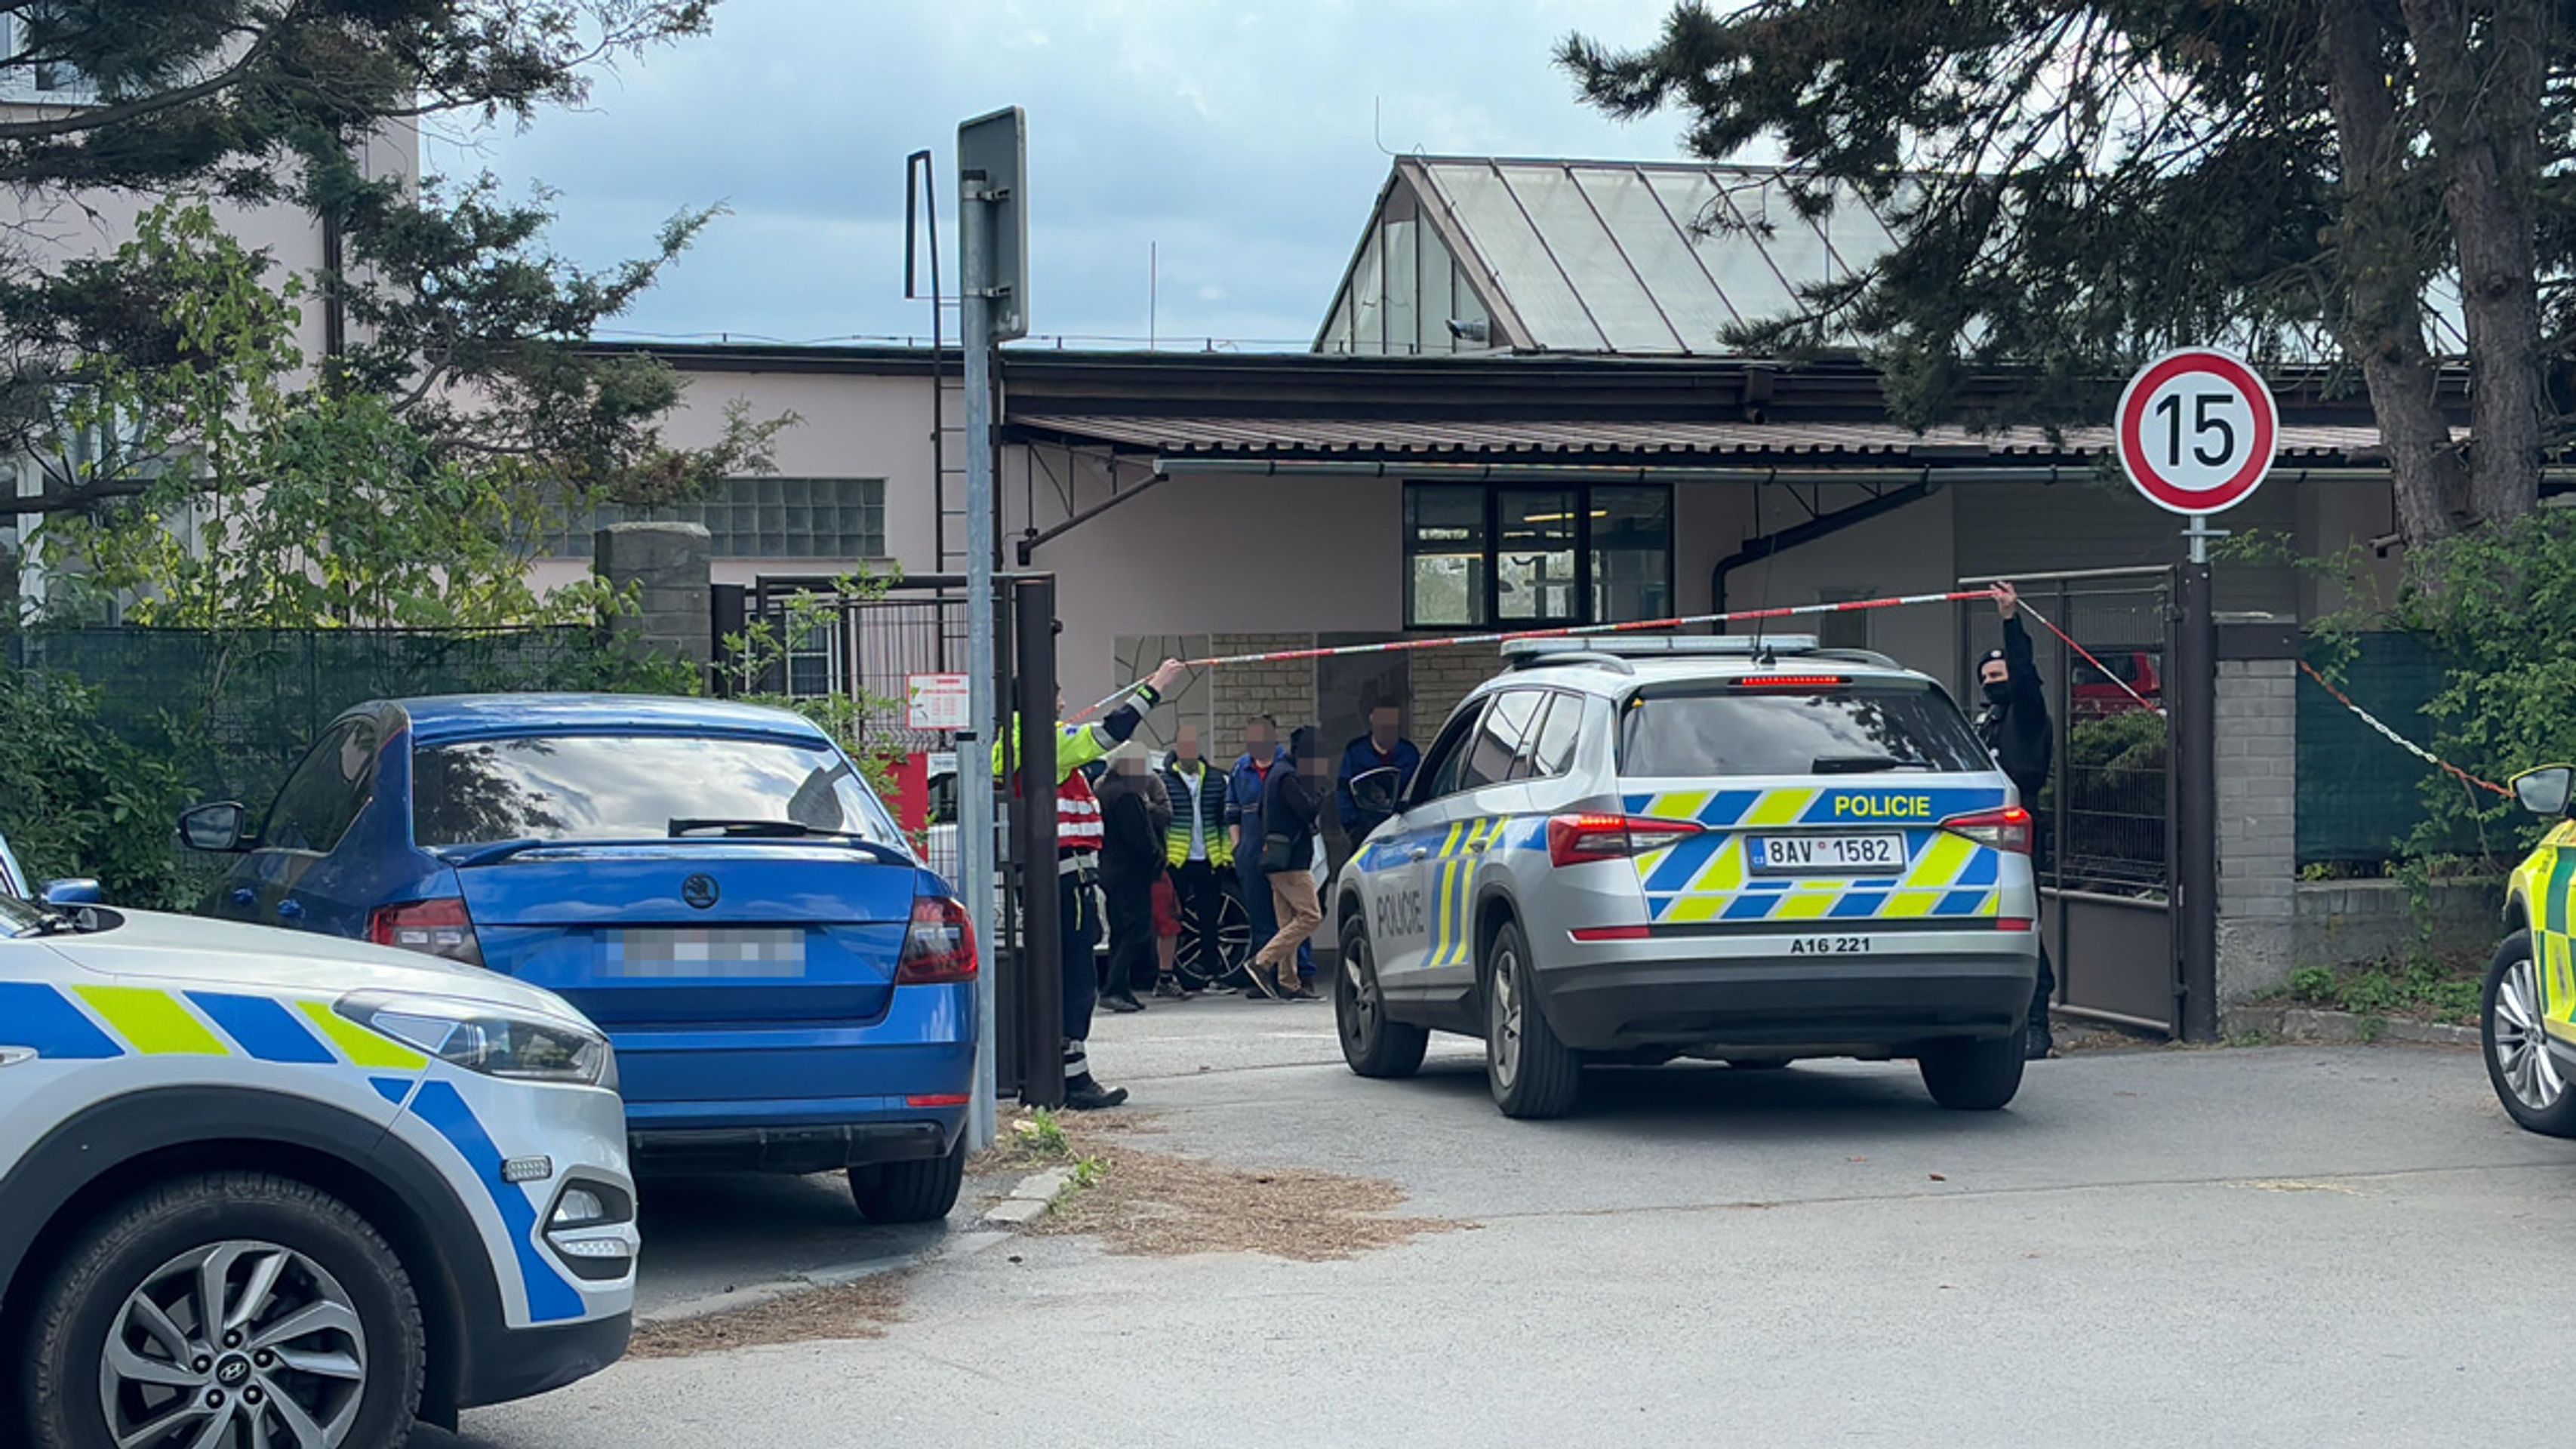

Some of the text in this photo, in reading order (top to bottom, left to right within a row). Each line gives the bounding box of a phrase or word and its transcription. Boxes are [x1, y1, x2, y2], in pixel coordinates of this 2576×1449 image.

[2156, 394, 2234, 466] 15
[1834, 795, 1931, 817] POLICIE
[1770, 839, 1891, 863] 8AV 1582
[1376, 891, 1425, 938] POLICIE
[1790, 937, 1870, 954] A16 221
